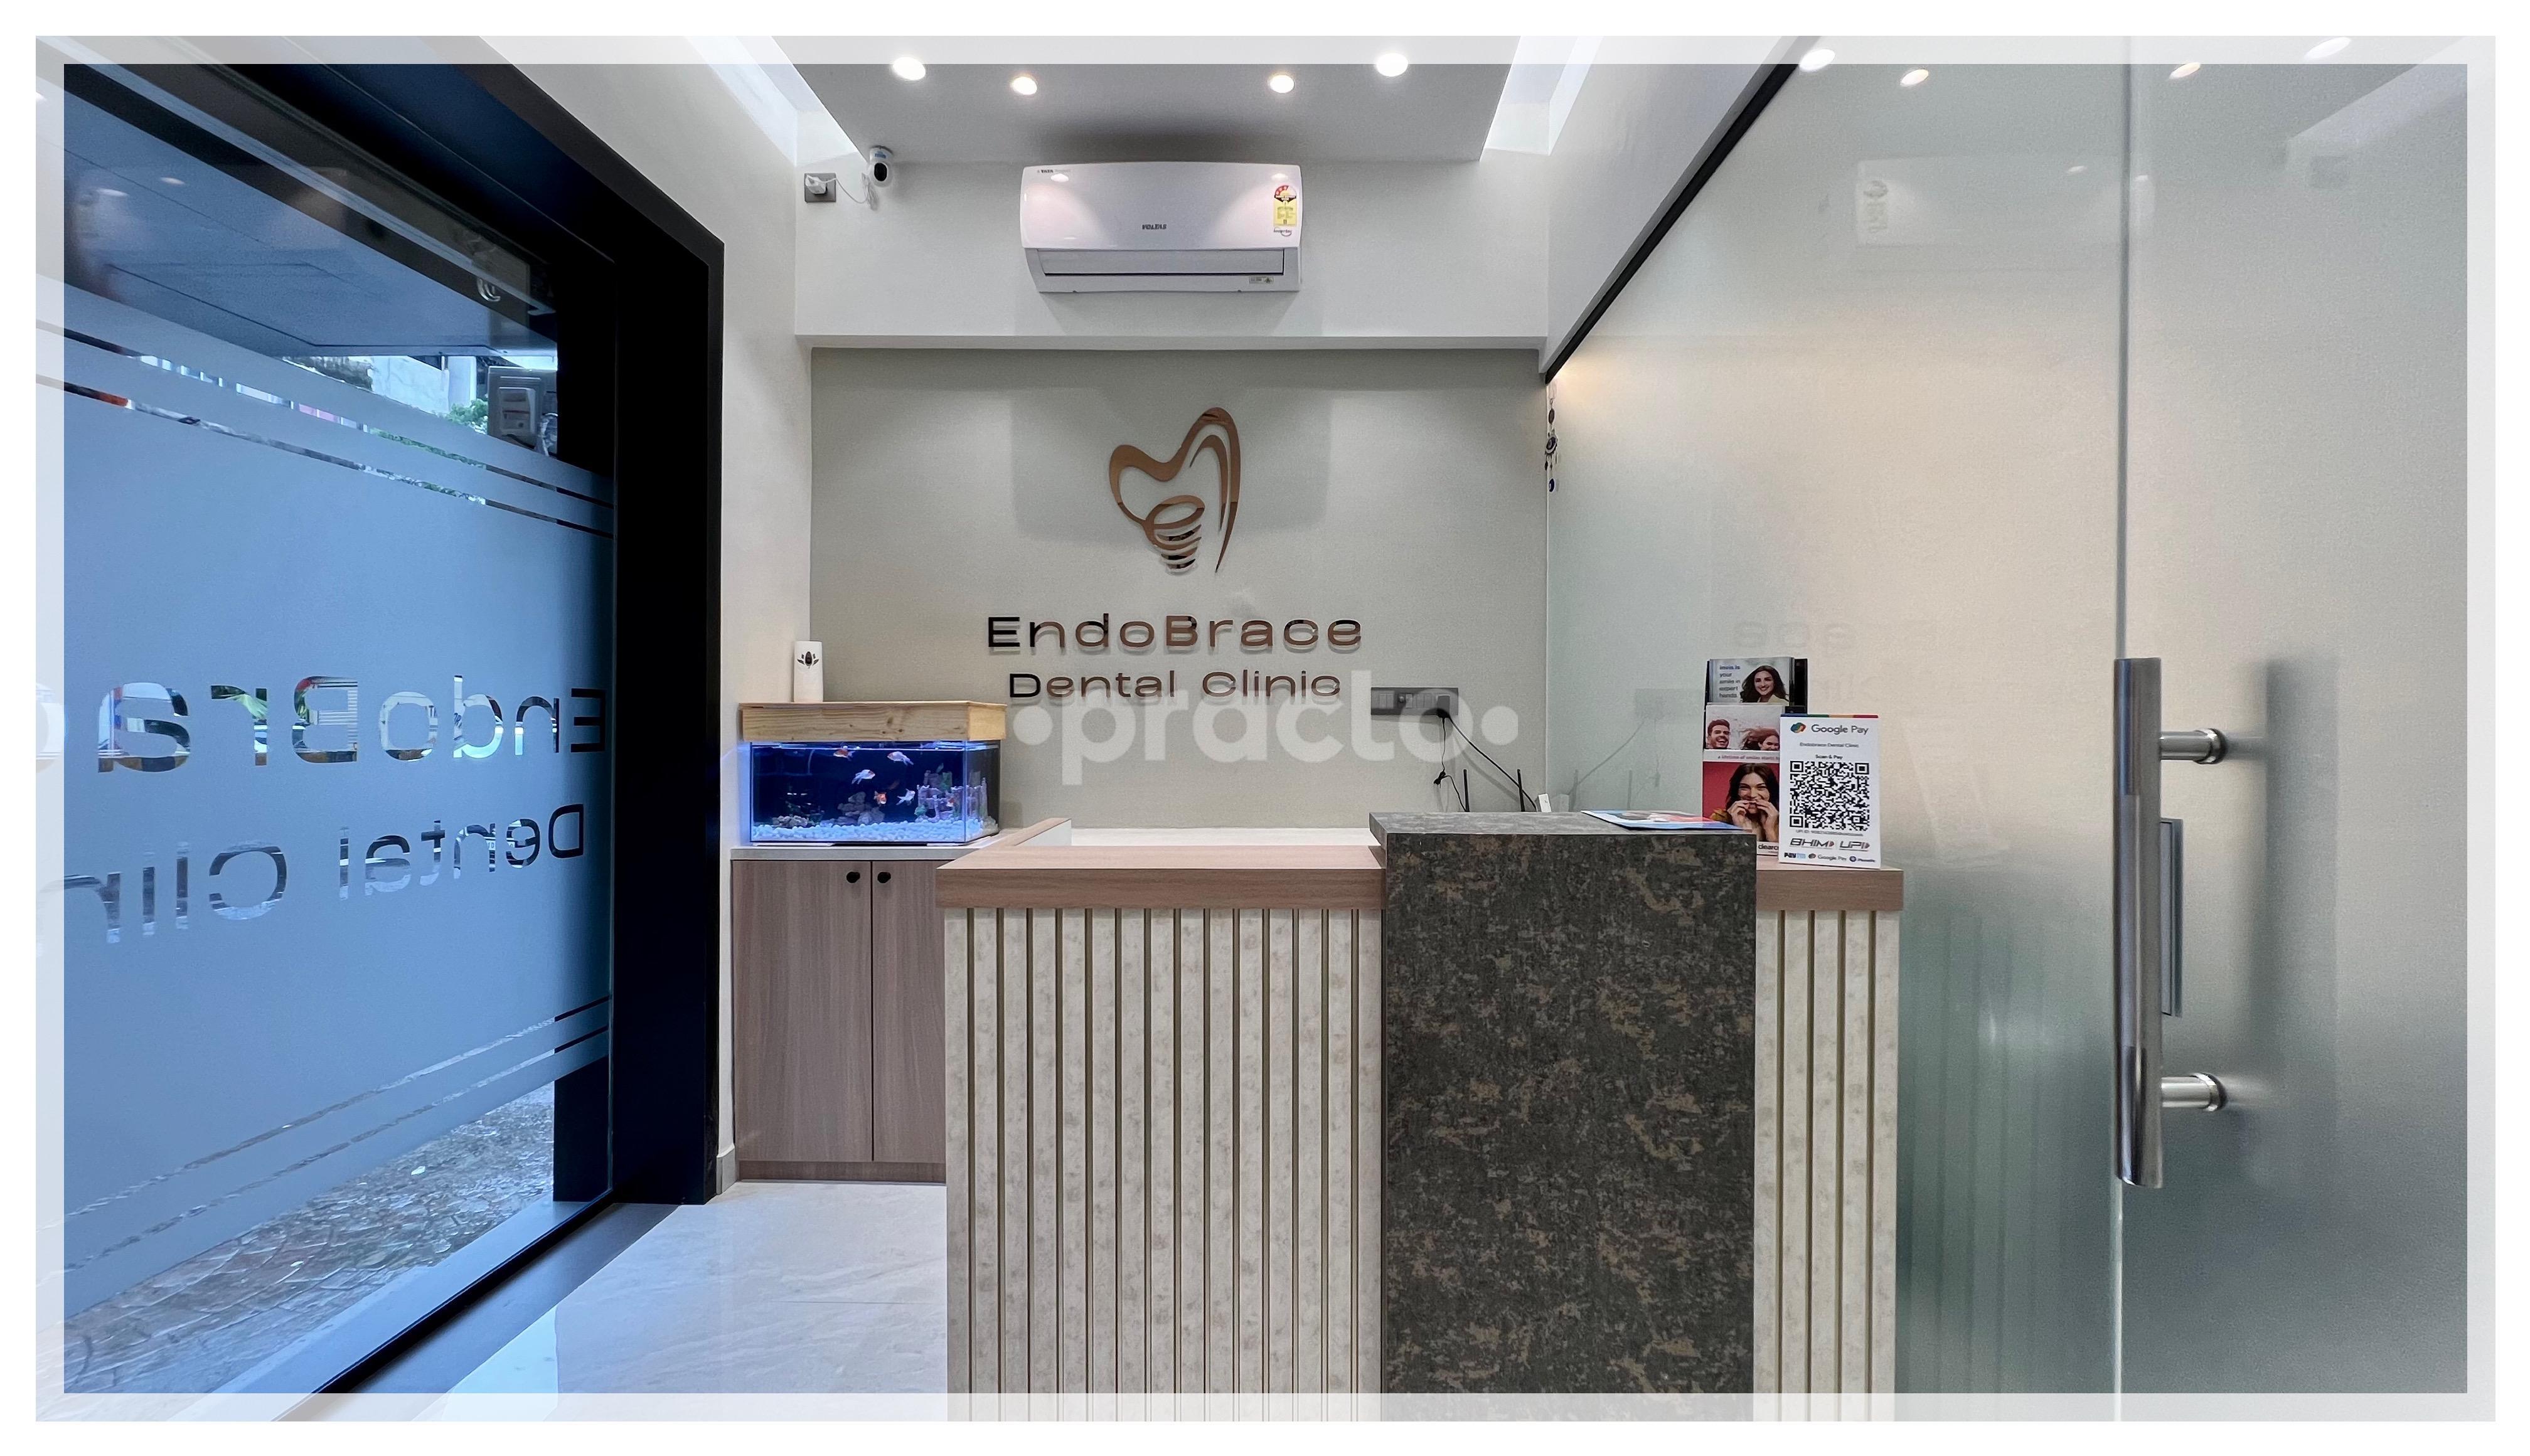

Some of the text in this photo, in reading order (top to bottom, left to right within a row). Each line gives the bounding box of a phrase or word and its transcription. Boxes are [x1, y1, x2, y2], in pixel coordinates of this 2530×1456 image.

[988, 613, 1362, 648] EndoBrace
[1009, 669, 1341, 698] Dental Clinic
[1811, 724, 1869, 735] Google Pay
[1790, 838, 1830, 848] BHIM
